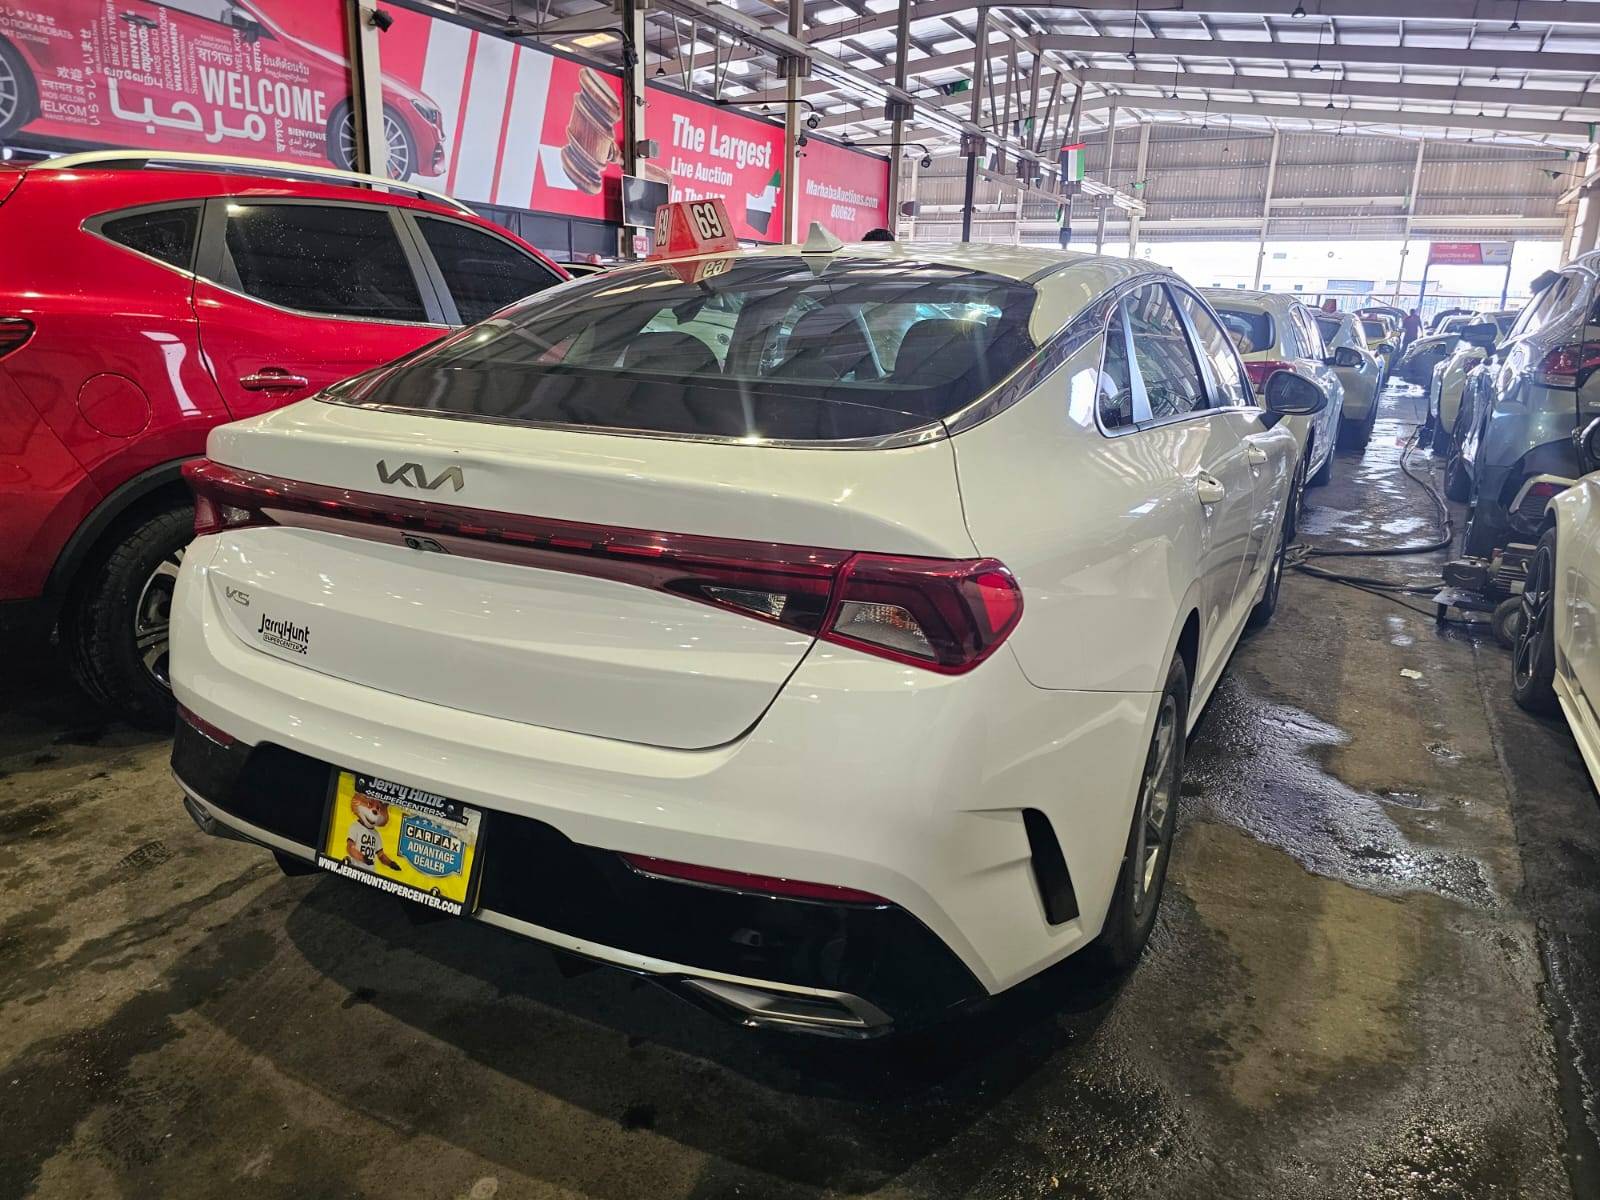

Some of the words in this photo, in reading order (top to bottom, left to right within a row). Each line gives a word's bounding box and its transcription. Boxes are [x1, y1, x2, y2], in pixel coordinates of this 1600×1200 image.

[170, 22, 182, 91] WILLKOMMEN
[199, 65, 327, 125] WELCOME
[108, 77, 266, 143] مرحبا
[288, 127, 327, 142] BIENVENUE
[672, 113, 705, 152] The
[709, 125, 772, 169] Largest
[671, 156, 693, 178] Live
[695, 162, 733, 186] Auction
[671, 185, 682, 203] In
[692, 203, 724, 238] 69
[264, 634, 300, 651] SUPERCENTER
[369, 777, 408, 800] Jerry
[408, 789, 447, 808] Hunt
[375, 793, 437, 815] SUPERCENTER
[361, 833, 376, 847] CAR
[406, 825, 461, 852] CARFAX
[361, 845, 376, 861] FOX
[408, 841, 455, 865] ADVANTAGE
[414, 855, 445, 873] DEALER
[318, 857, 462, 916] WWW.JERRYHUNTSUPERCENTER.COM
